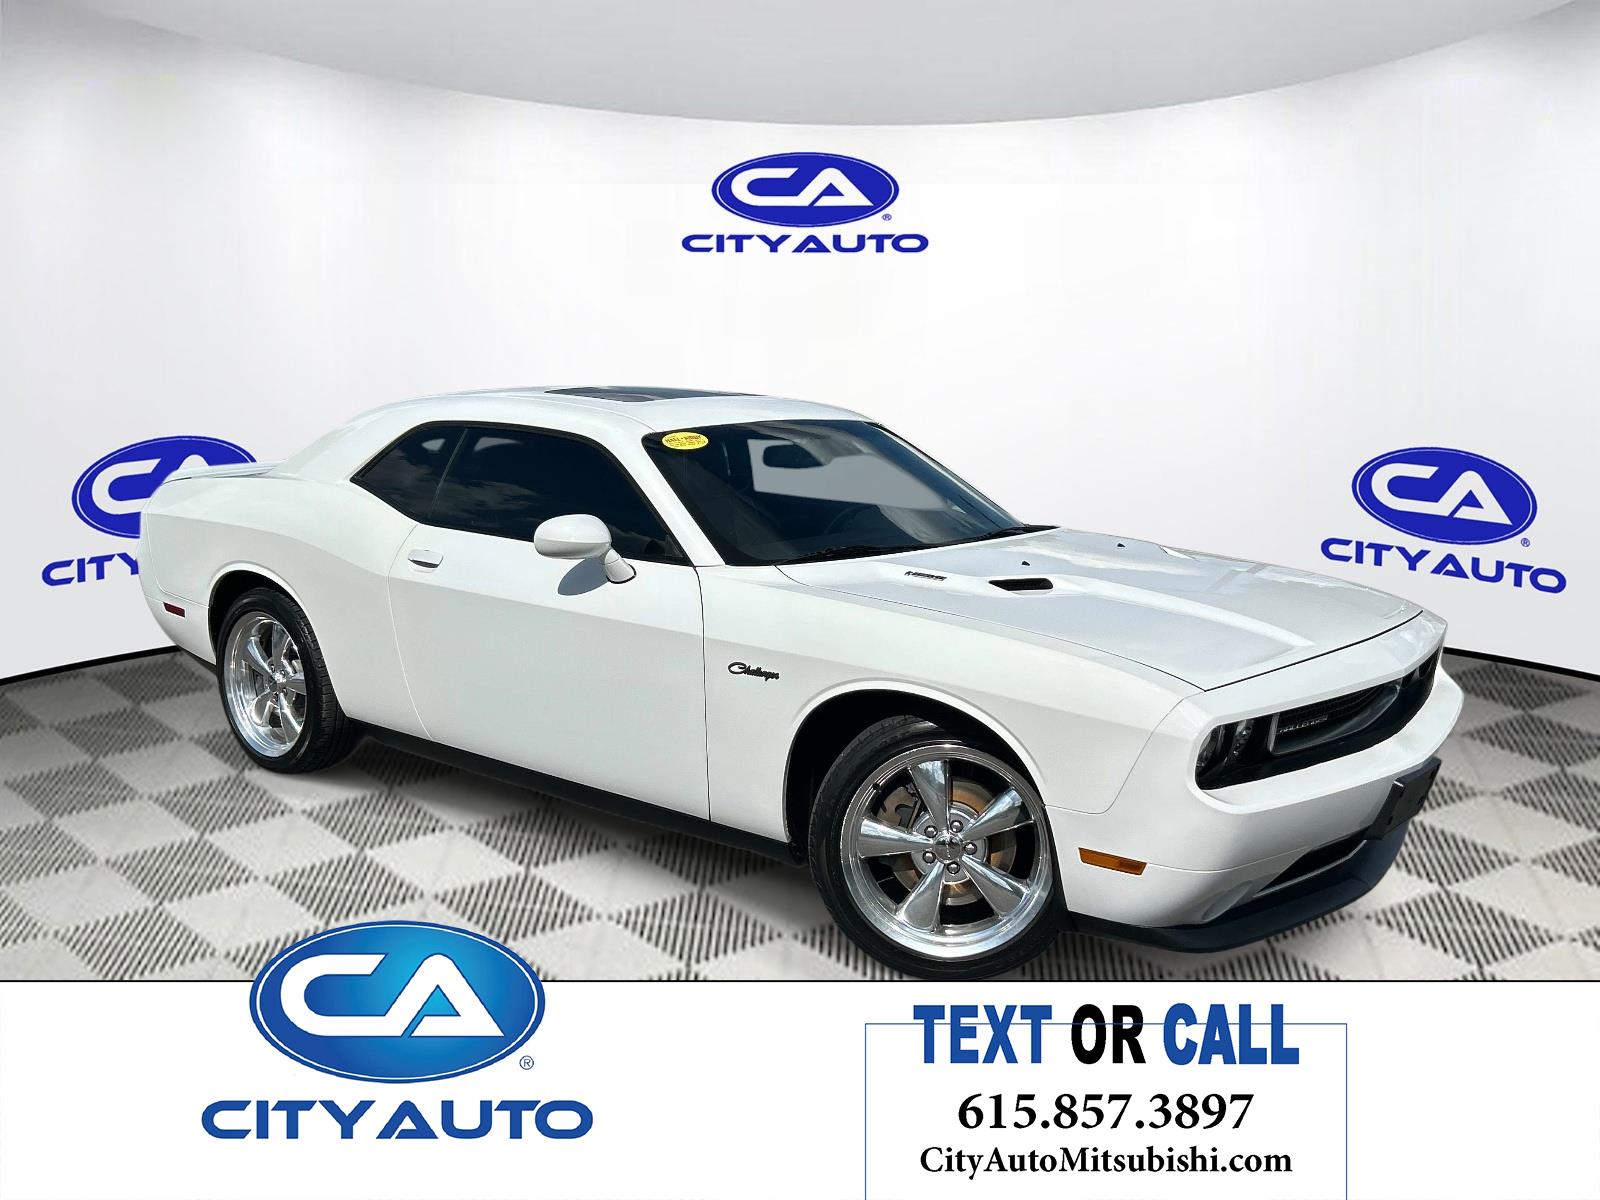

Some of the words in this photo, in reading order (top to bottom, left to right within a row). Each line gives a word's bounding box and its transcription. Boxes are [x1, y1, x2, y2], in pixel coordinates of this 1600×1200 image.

[731, 167, 874, 206] CA
[682, 234, 792, 253] CITY
[792, 234, 929, 253] AUTO
[1371, 462, 1513, 525] CA
[1320, 537, 1431, 572] CITY
[1430, 553, 1567, 594] AUTO
